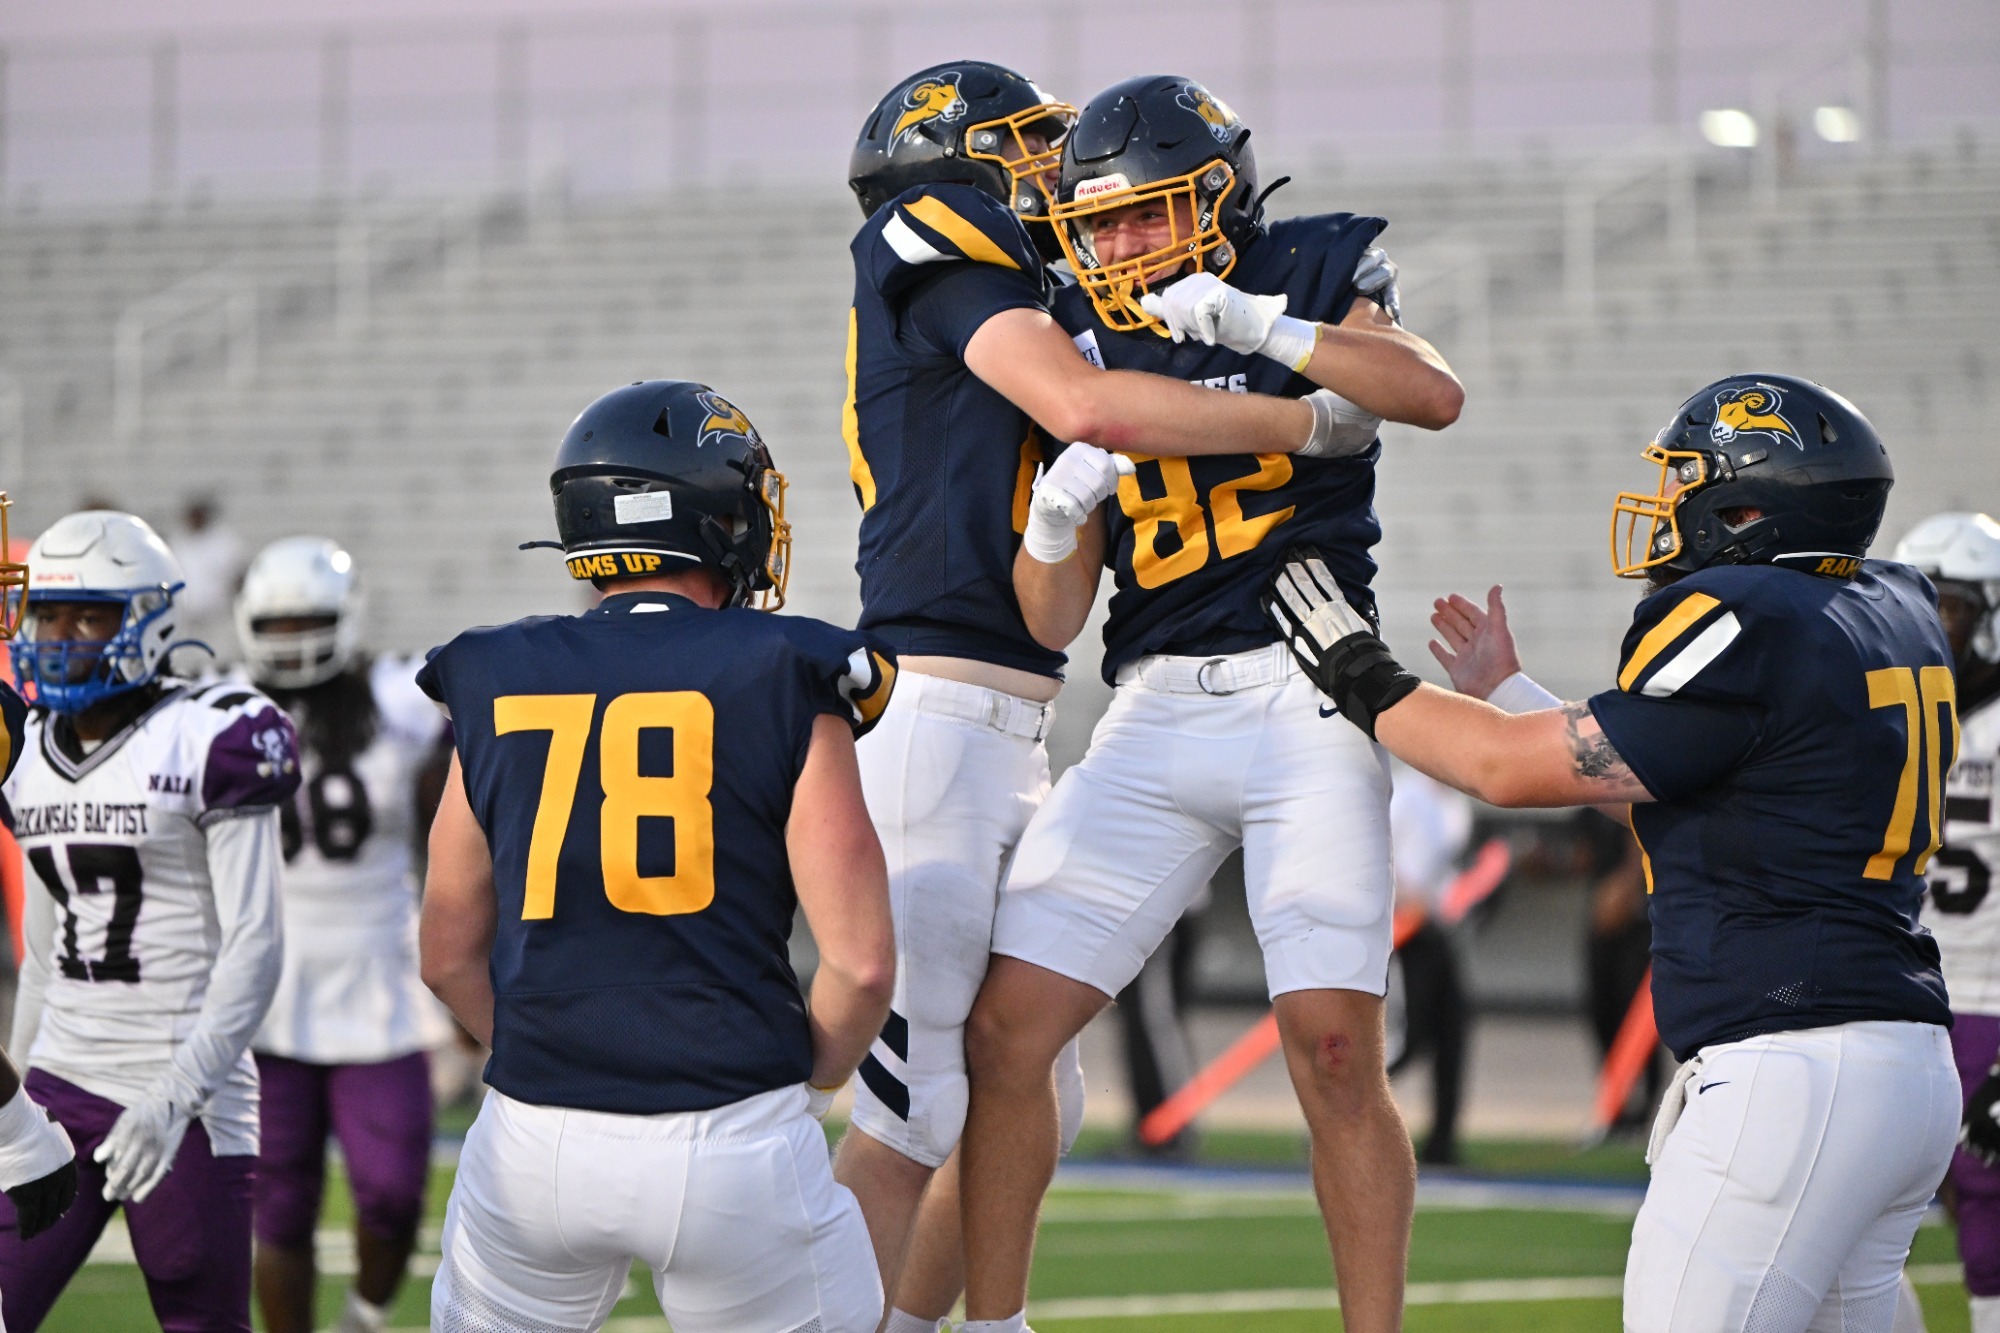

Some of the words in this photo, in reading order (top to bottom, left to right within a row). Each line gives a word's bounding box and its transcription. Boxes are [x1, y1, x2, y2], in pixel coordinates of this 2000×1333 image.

[567, 554, 618, 578] RAMS
[621, 553, 662, 573] UP
[1116, 451, 1297, 590] 82
[84, 803, 148, 834] BAPTIST
[149, 774, 192, 796] NAIA
[493, 690, 715, 920] 78
[1862, 666, 1960, 881] 70
[28, 843, 143, 983] 17
